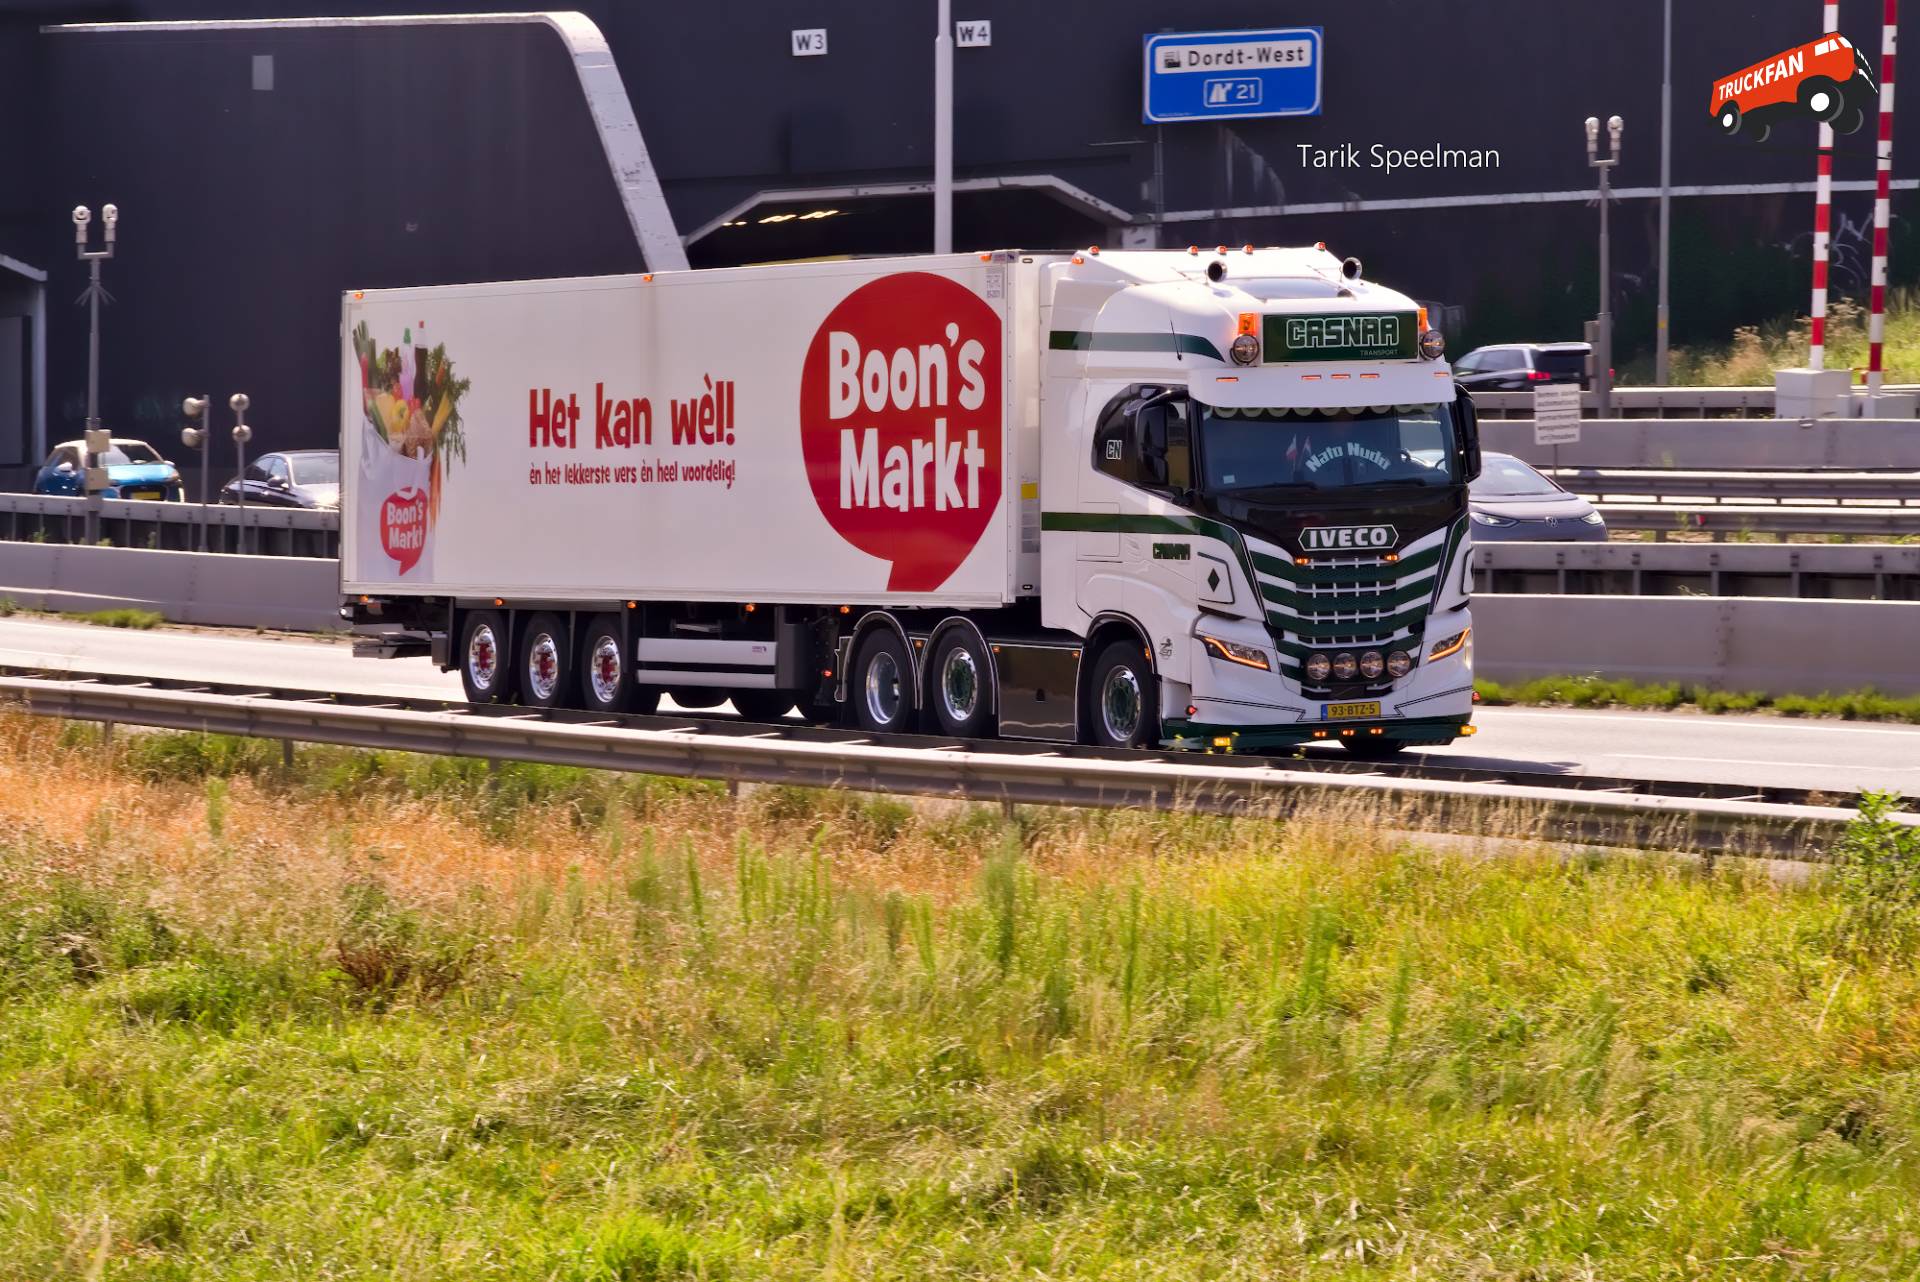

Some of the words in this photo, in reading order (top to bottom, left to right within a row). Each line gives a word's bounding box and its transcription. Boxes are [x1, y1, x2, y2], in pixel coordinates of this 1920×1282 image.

[1188, 47, 1304, 66] Dordt-West
[1236, 84, 1256, 99] 21
[1286, 316, 1399, 349] CASNAA
[1360, 348, 1398, 357] TRANSPORT
[829, 322, 986, 420] Boon's
[529, 388, 580, 449] Het
[595, 382, 652, 449] kan
[670, 372, 735, 446] wèl!
[839, 417, 985, 513] Markt
[1305, 446, 1344, 473] Nato
[545, 461, 561, 485] het
[564, 463, 610, 485] lekkerste
[614, 464, 637, 484] vers
[656, 458, 678, 482] heel
[682, 459, 736, 490] voordelig!
[389, 525, 423, 549] Markt
[1309, 527, 1388, 548] IVECO
[1331, 703, 1375, 716] 93-BTZ-5
